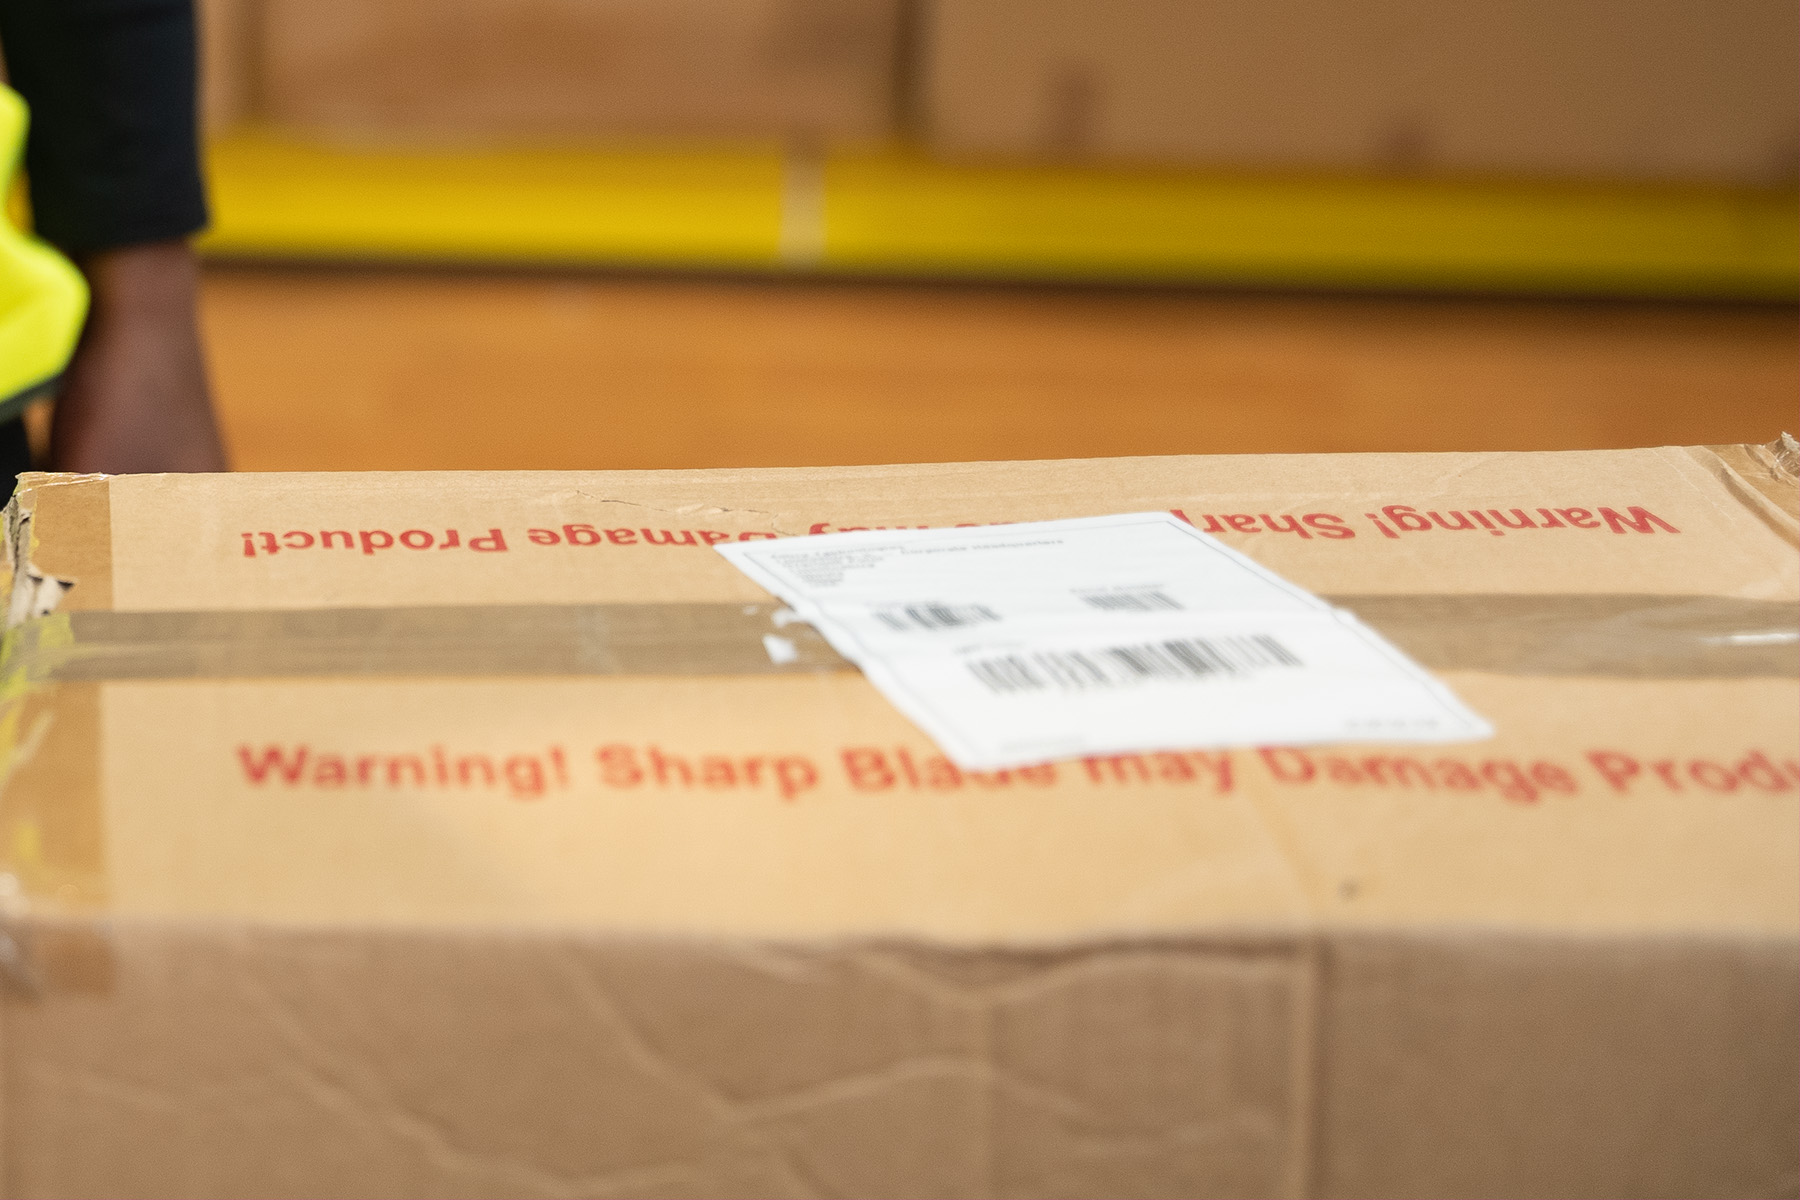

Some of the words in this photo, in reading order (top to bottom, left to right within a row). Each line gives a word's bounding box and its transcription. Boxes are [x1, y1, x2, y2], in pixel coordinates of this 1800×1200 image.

[1379, 504, 1682, 540] Warning!
[239, 530, 509, 559] Product!
[234, 742, 572, 802] Warning!
[595, 744, 820, 802] Sharp
[1256, 745, 1580, 804] Damage
